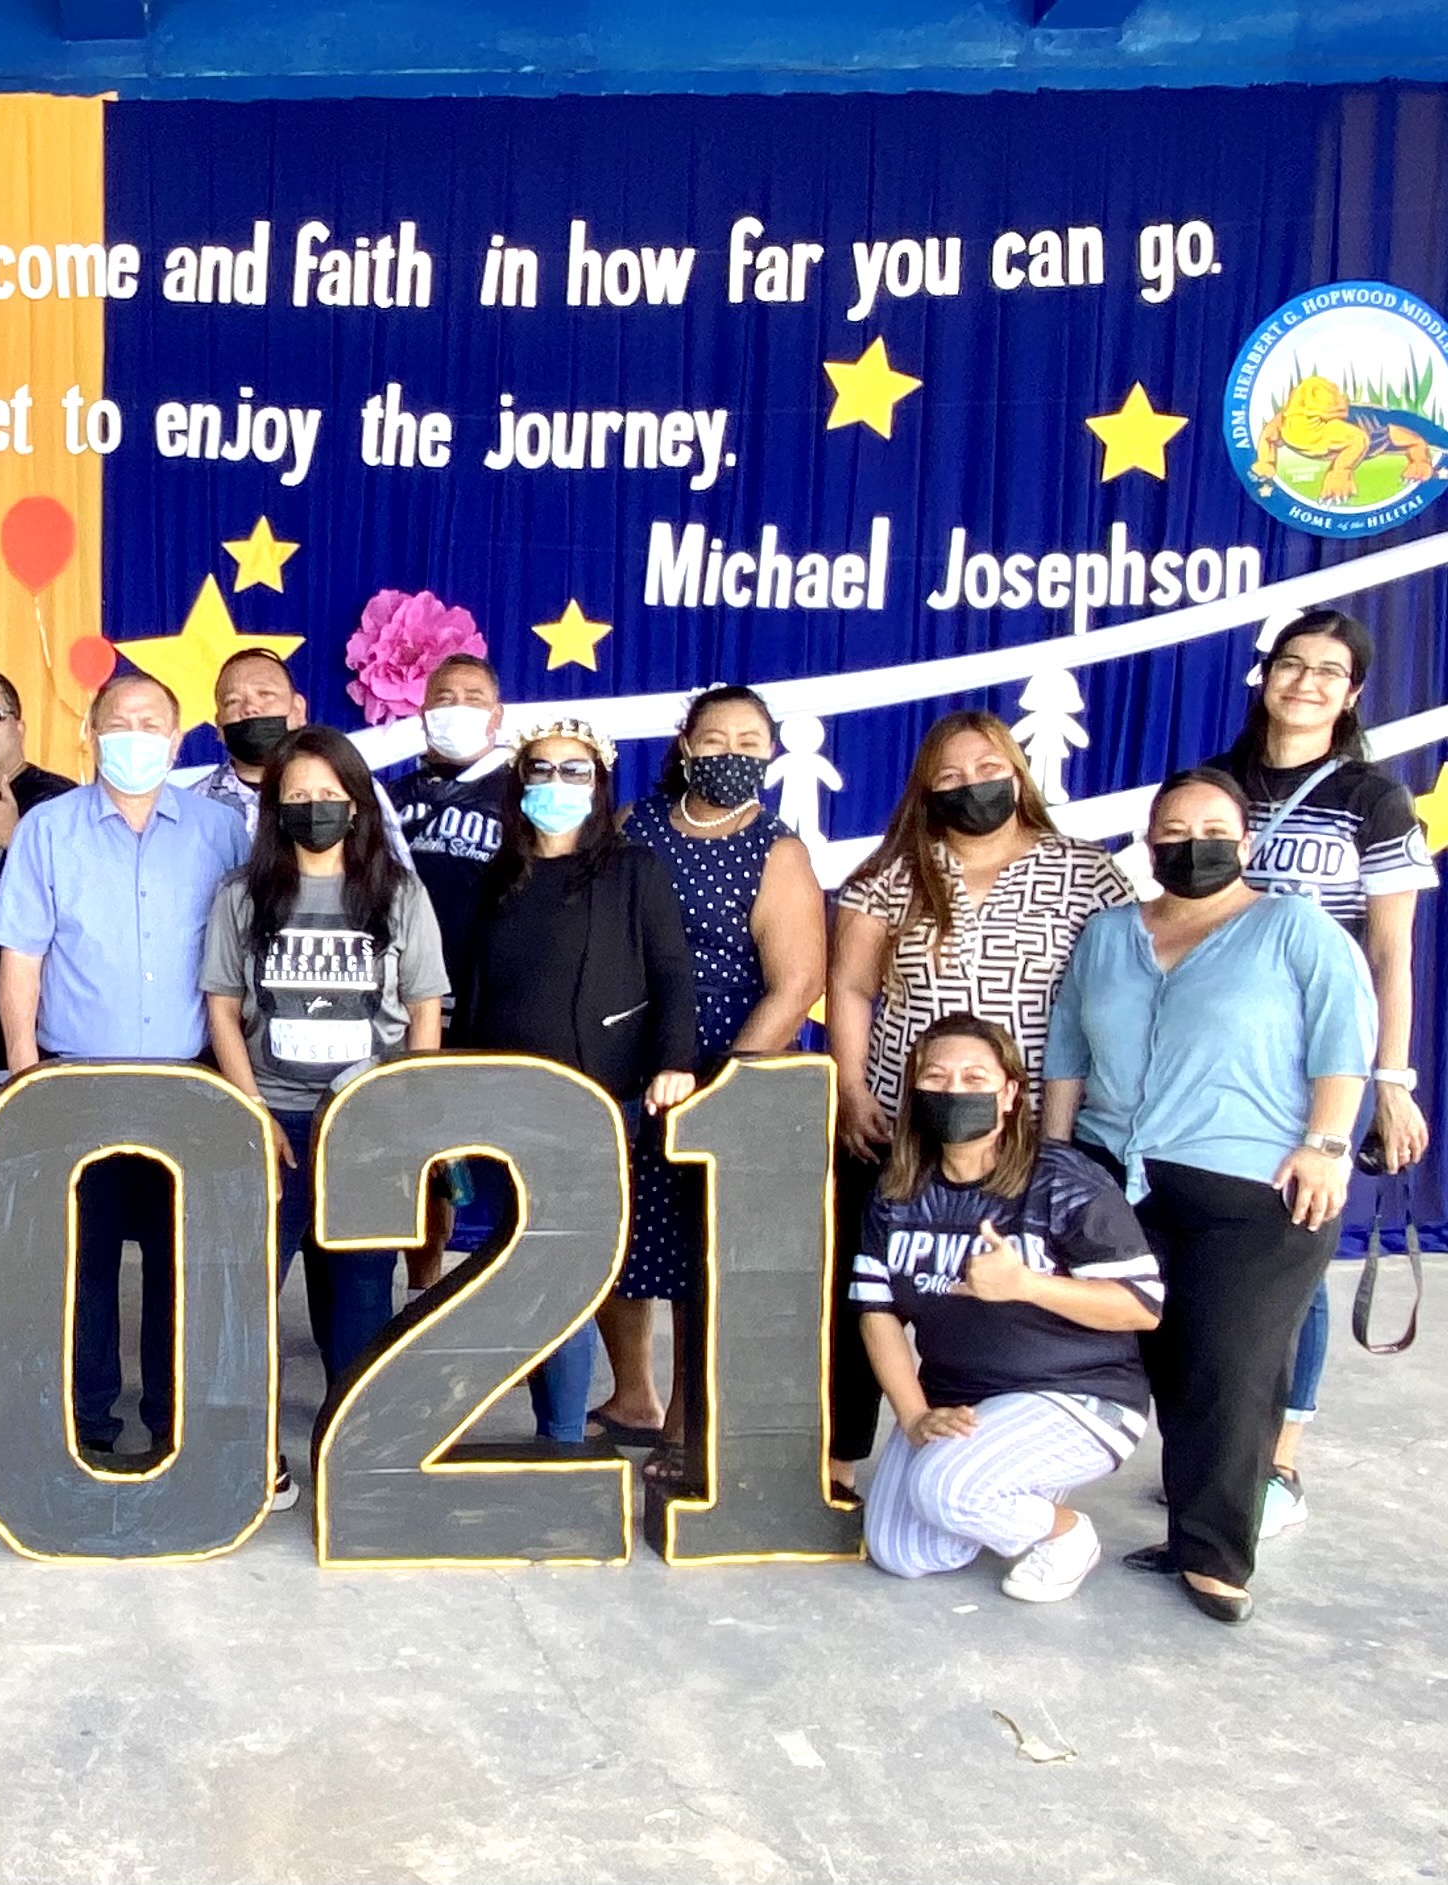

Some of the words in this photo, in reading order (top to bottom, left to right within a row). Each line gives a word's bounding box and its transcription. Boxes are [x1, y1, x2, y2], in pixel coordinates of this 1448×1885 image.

[163, 220, 271, 307] and
[292, 220, 432, 308] faith
[480, 234, 538, 308] in
[567, 219, 696, 307] how
[728, 216, 825, 304] far
[847, 237, 961, 322] you
[992, 226, 1104, 291] can
[1140, 220, 1223, 304] go.
[1232, 321, 1283, 399] HERBERT
[1300, 288, 1397, 317] HOPWOOD
[61, 384, 122, 455] to
[155, 387, 322, 487] enjoy
[361, 382, 452, 468] the
[484, 393, 737, 491] journey.
[1288, 505, 1333, 530] HOME
[644, 517, 890, 610] Michael
[926, 521, 1261, 636] Josephson
[265, 954, 374, 973] RESPECT
[273, 1040, 368, 1060] MYSELF
